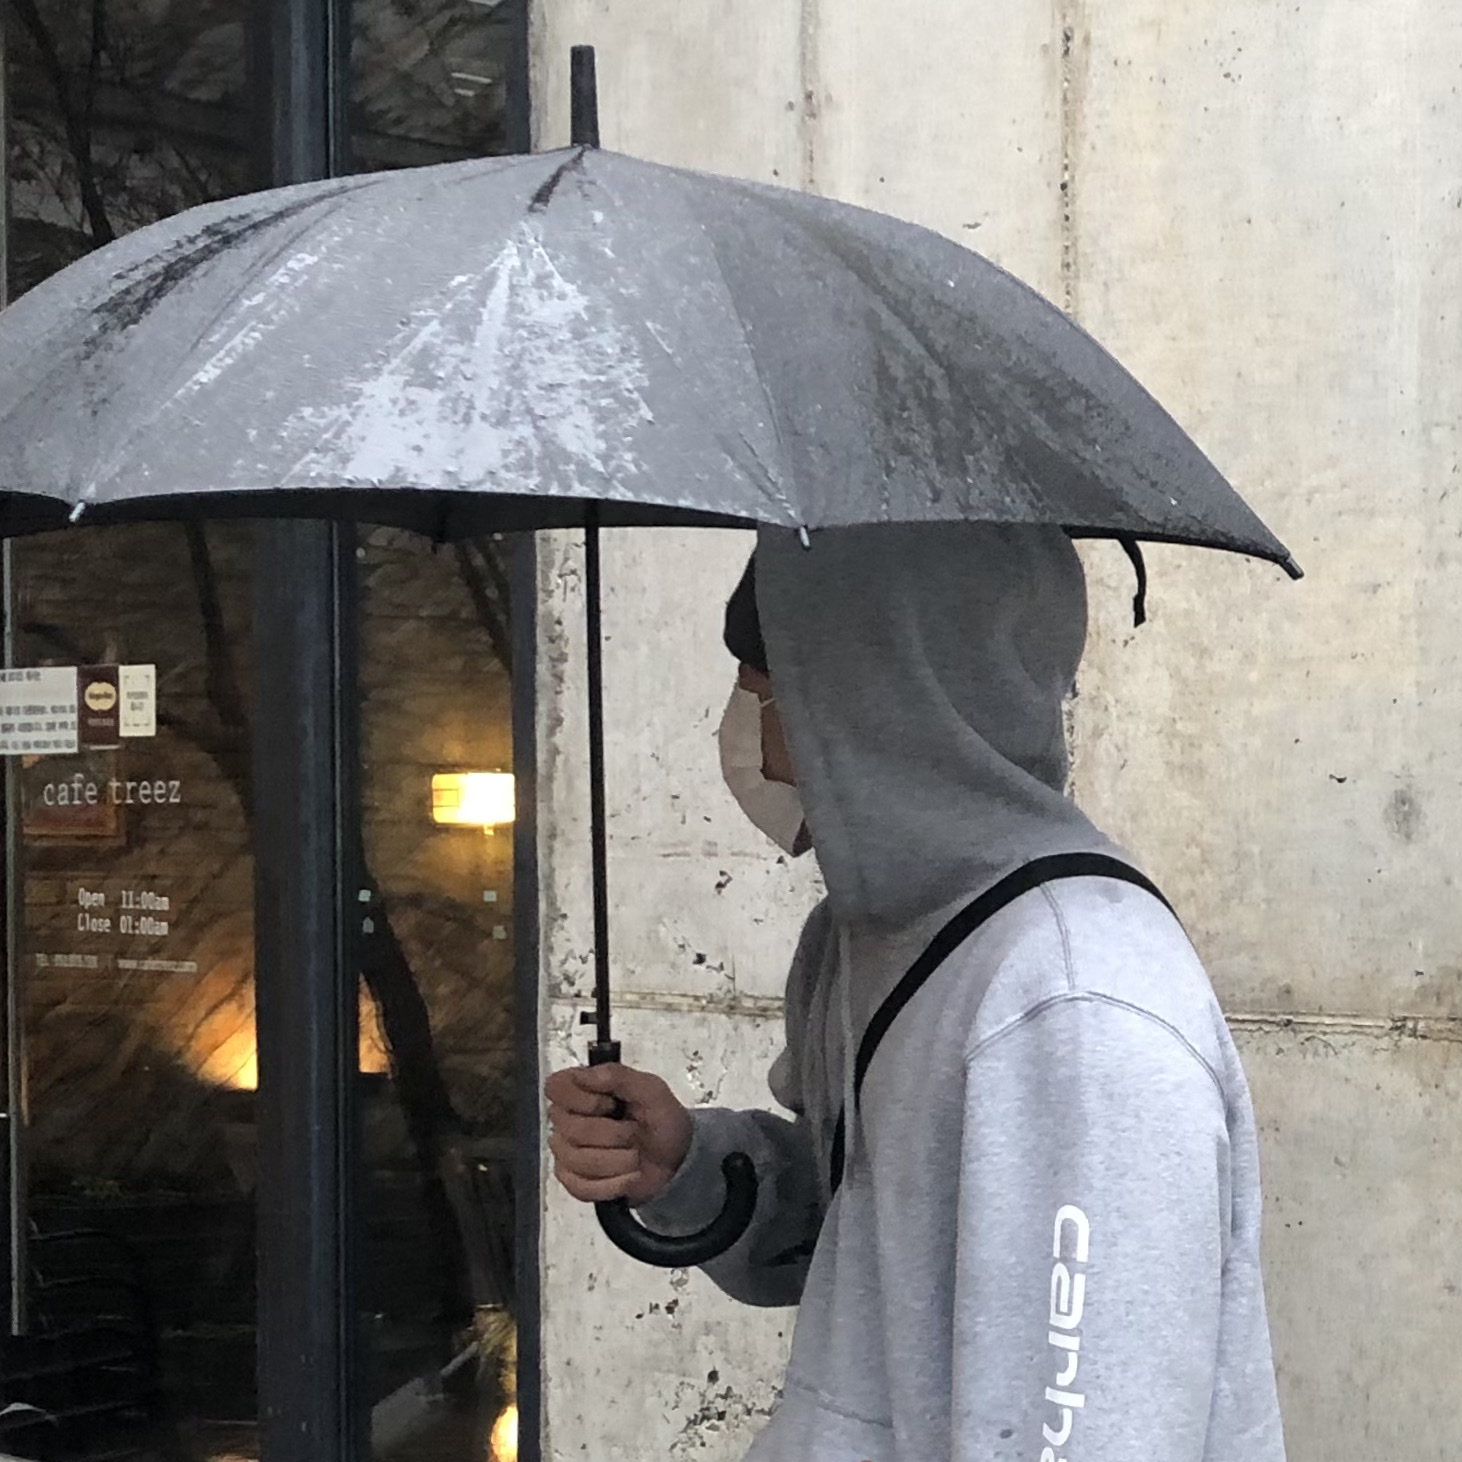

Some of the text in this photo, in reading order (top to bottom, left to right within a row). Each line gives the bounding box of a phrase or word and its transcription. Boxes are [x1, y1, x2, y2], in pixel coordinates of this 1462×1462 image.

[43, 772, 181, 805] cafe treez
[78, 887, 105, 909] Open
[78, 913, 111, 932] Close
